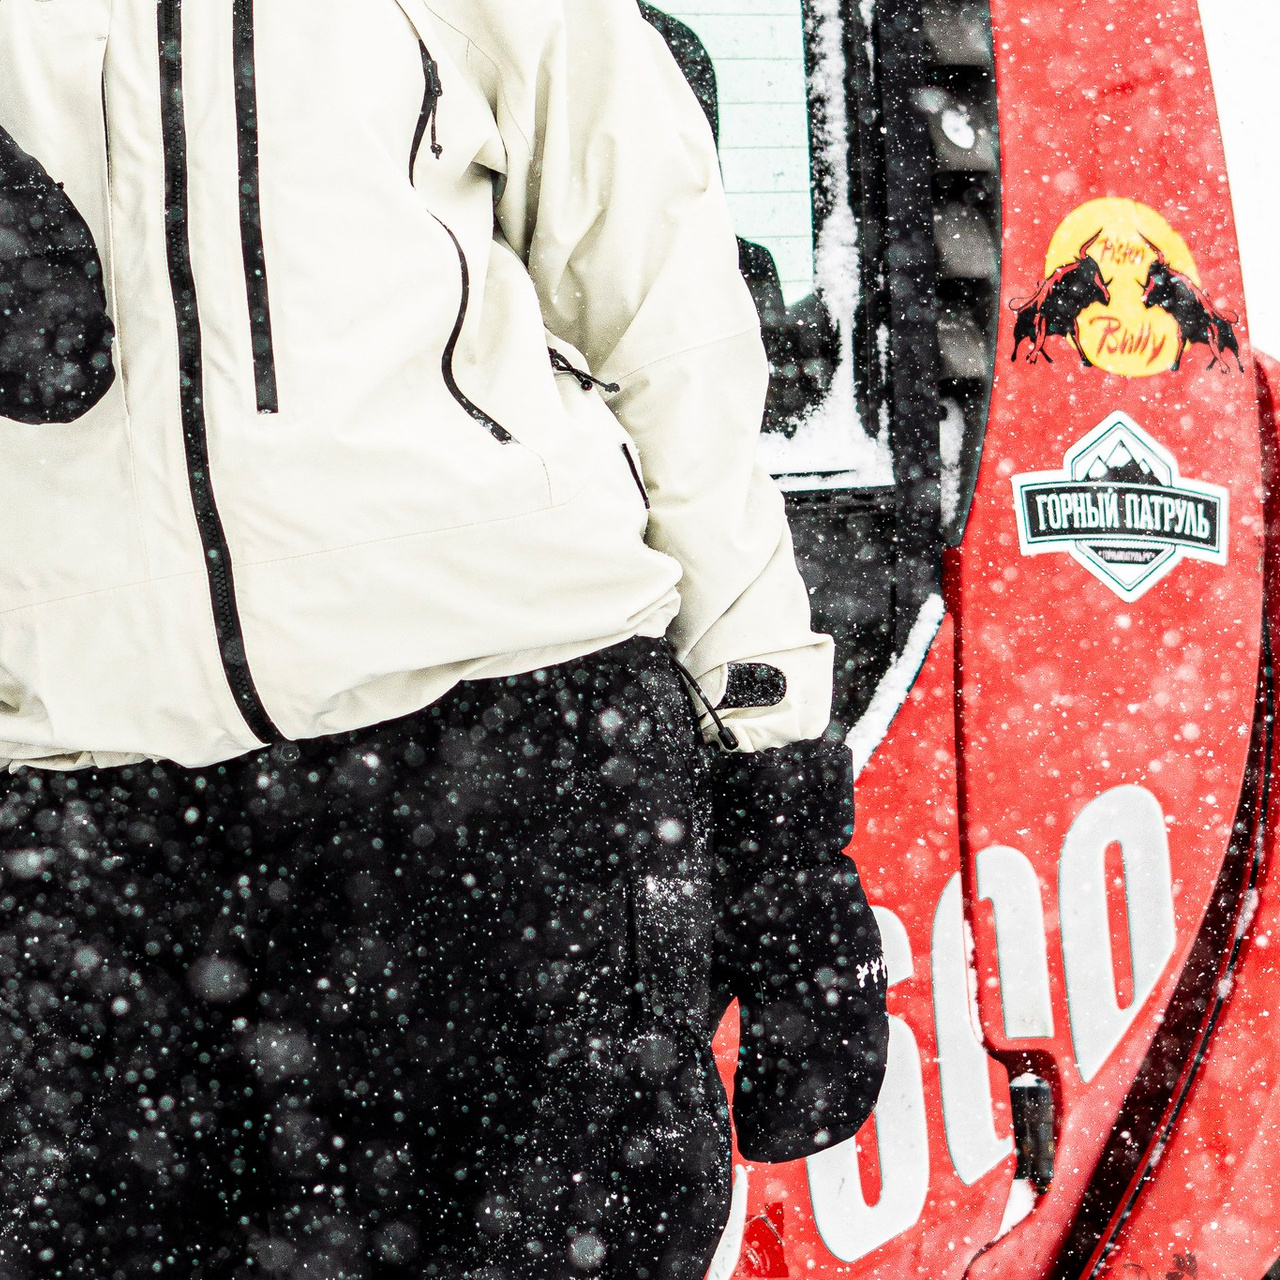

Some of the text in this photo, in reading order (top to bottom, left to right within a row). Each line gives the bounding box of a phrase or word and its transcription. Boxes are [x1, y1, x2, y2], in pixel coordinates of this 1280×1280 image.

[1089, 316, 1166, 367] Bully
[1035, 488, 1211, 539] ГОРНЫЙ ПАТРУЛЬ
